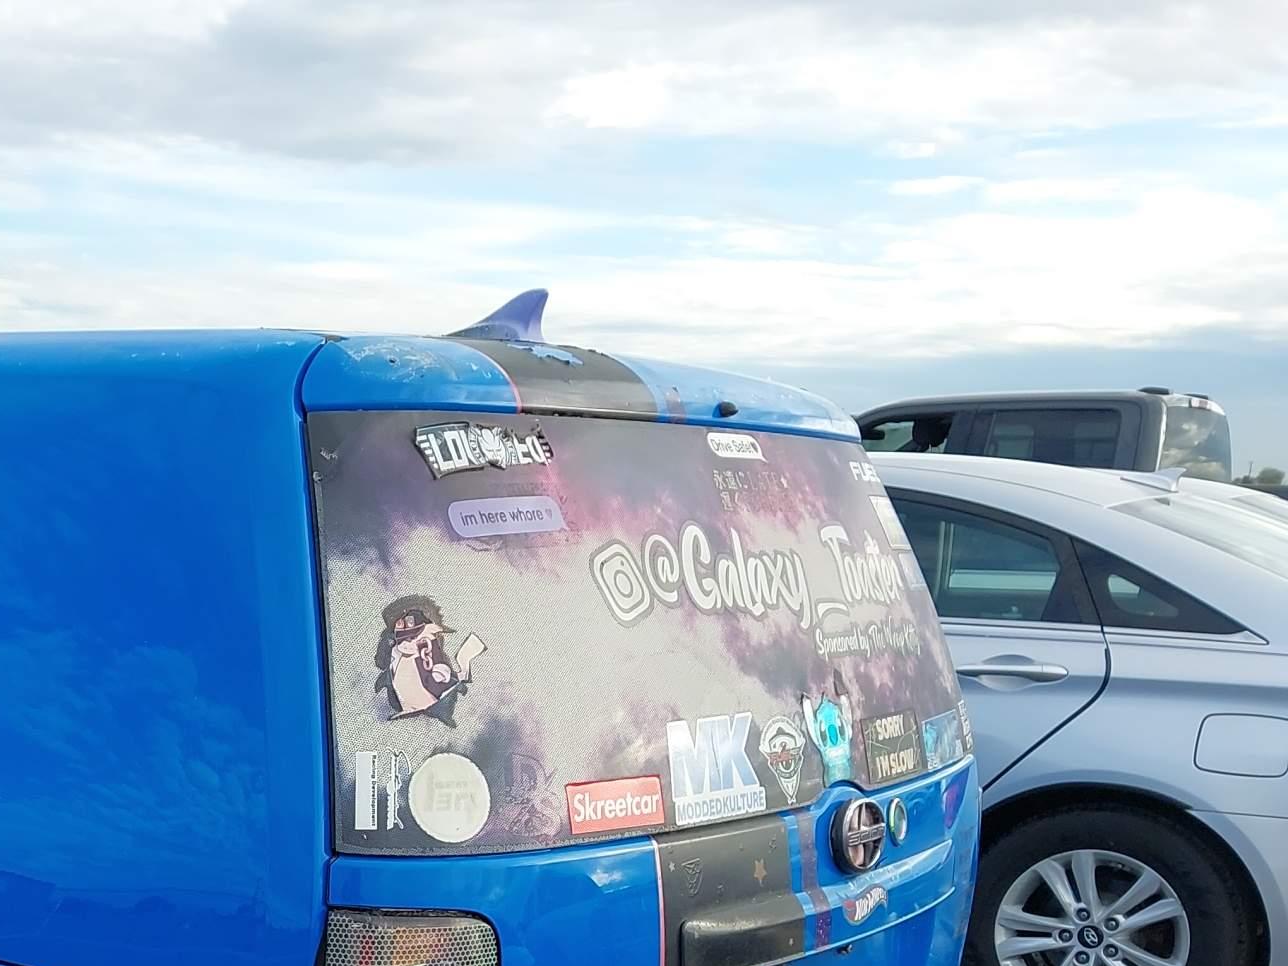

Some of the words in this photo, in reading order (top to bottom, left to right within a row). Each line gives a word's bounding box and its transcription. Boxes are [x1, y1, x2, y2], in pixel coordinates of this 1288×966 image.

[460, 512, 478, 527] im
[480, 509, 508, 524] here
[510, 507, 544, 522] whore
[876, 714, 905, 740] SORRY
[667, 712, 760, 801] MK
[574, 791, 660, 823] Skreetcar
[678, 790, 765, 821] MODDEDKULTURE
